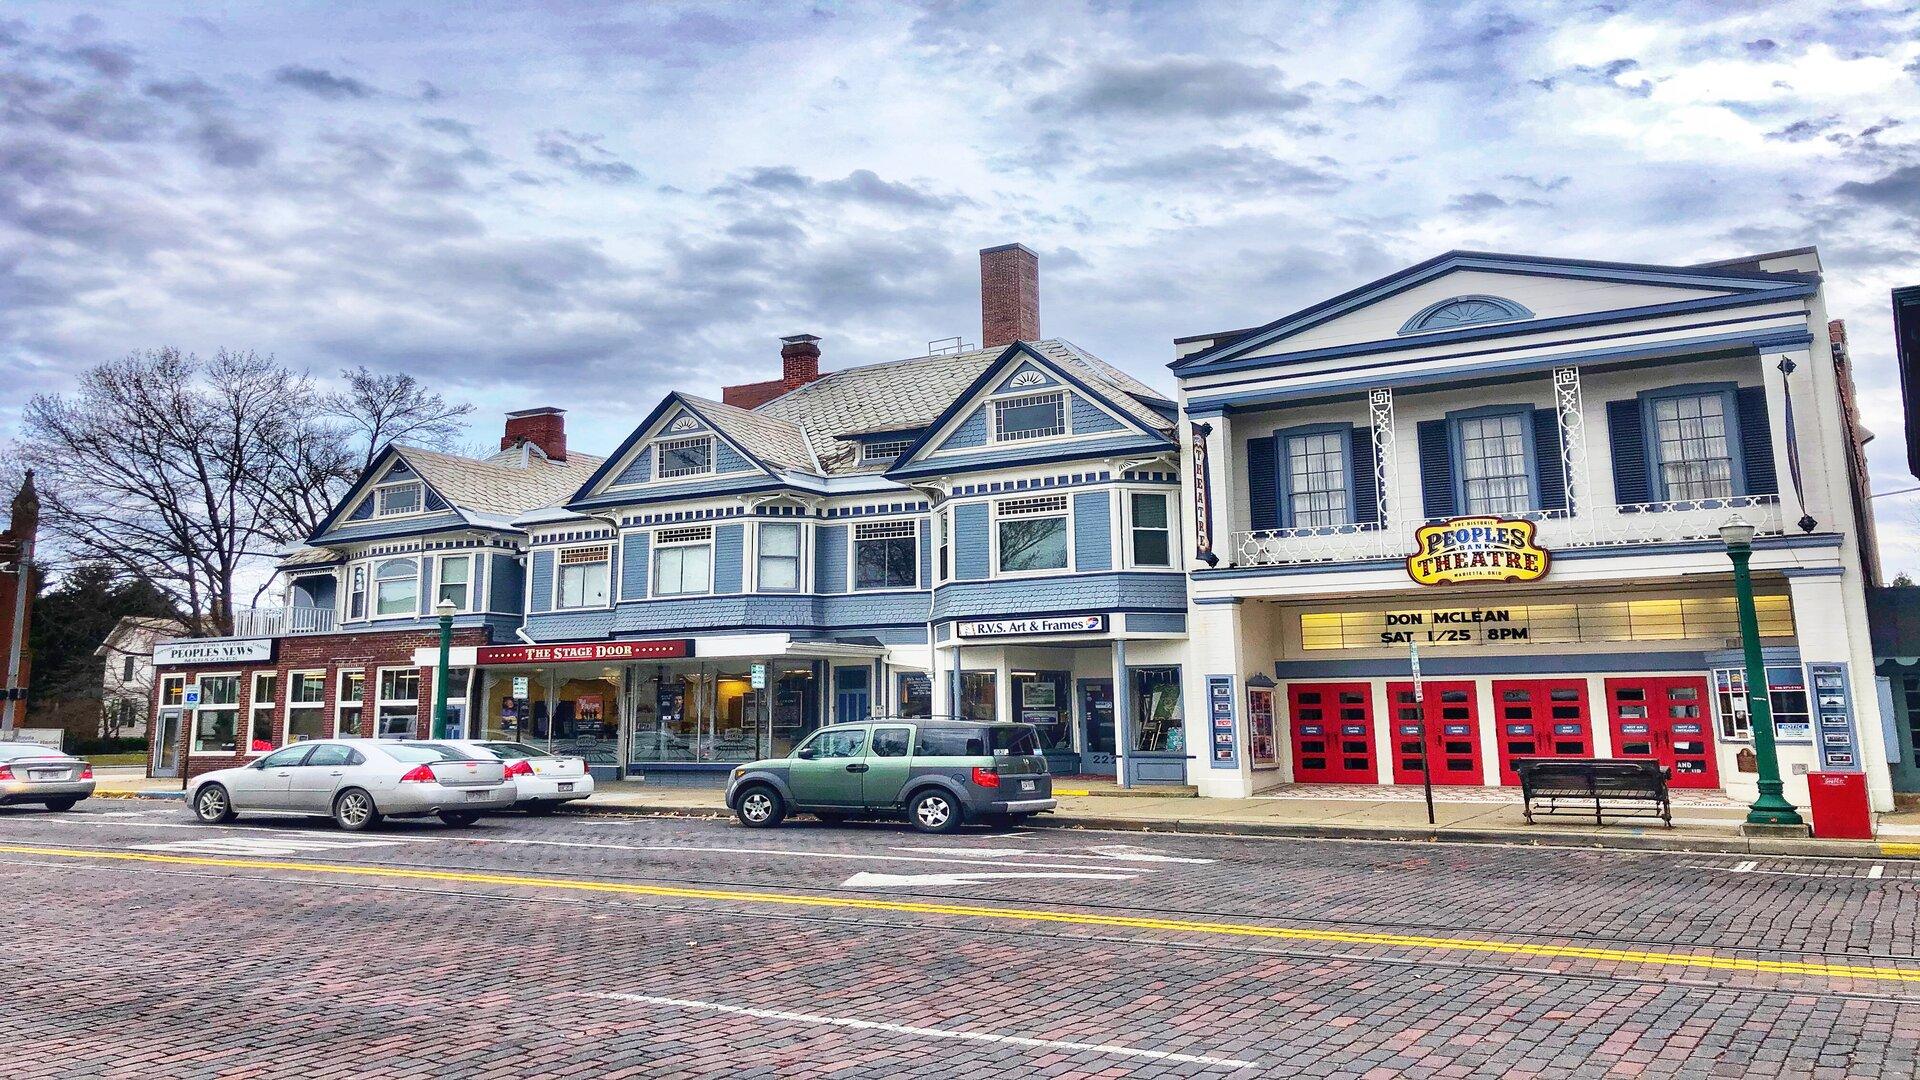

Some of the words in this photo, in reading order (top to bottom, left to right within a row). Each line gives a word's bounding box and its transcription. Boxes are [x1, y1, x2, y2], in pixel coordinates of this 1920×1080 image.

[1195, 450, 1205, 546] THEATRE
[1426, 527, 1525, 556] PEOPLES
[1418, 551, 1538, 577] THEATRE
[1387, 614, 1422, 625] DON
[1434, 610, 1509, 624] MCLEAN
[978, 623, 1006, 633] R.V.S.
[1009, 622, 1026, 632] Art
[1030, 621, 1039, 631] &
[1043, 620, 1083, 630] Frames
[1381, 631, 1414, 643] SAT
[1428, 630, 1471, 641] 1/25
[1488, 628, 1528, 640] 8PM
[171, 648, 219, 658] PEOPLES
[223, 646, 253, 656] NEWS
[525, 648, 551, 660] THE
[553, 647, 592, 659] STAGE
[596, 645, 632, 658] DOOR
